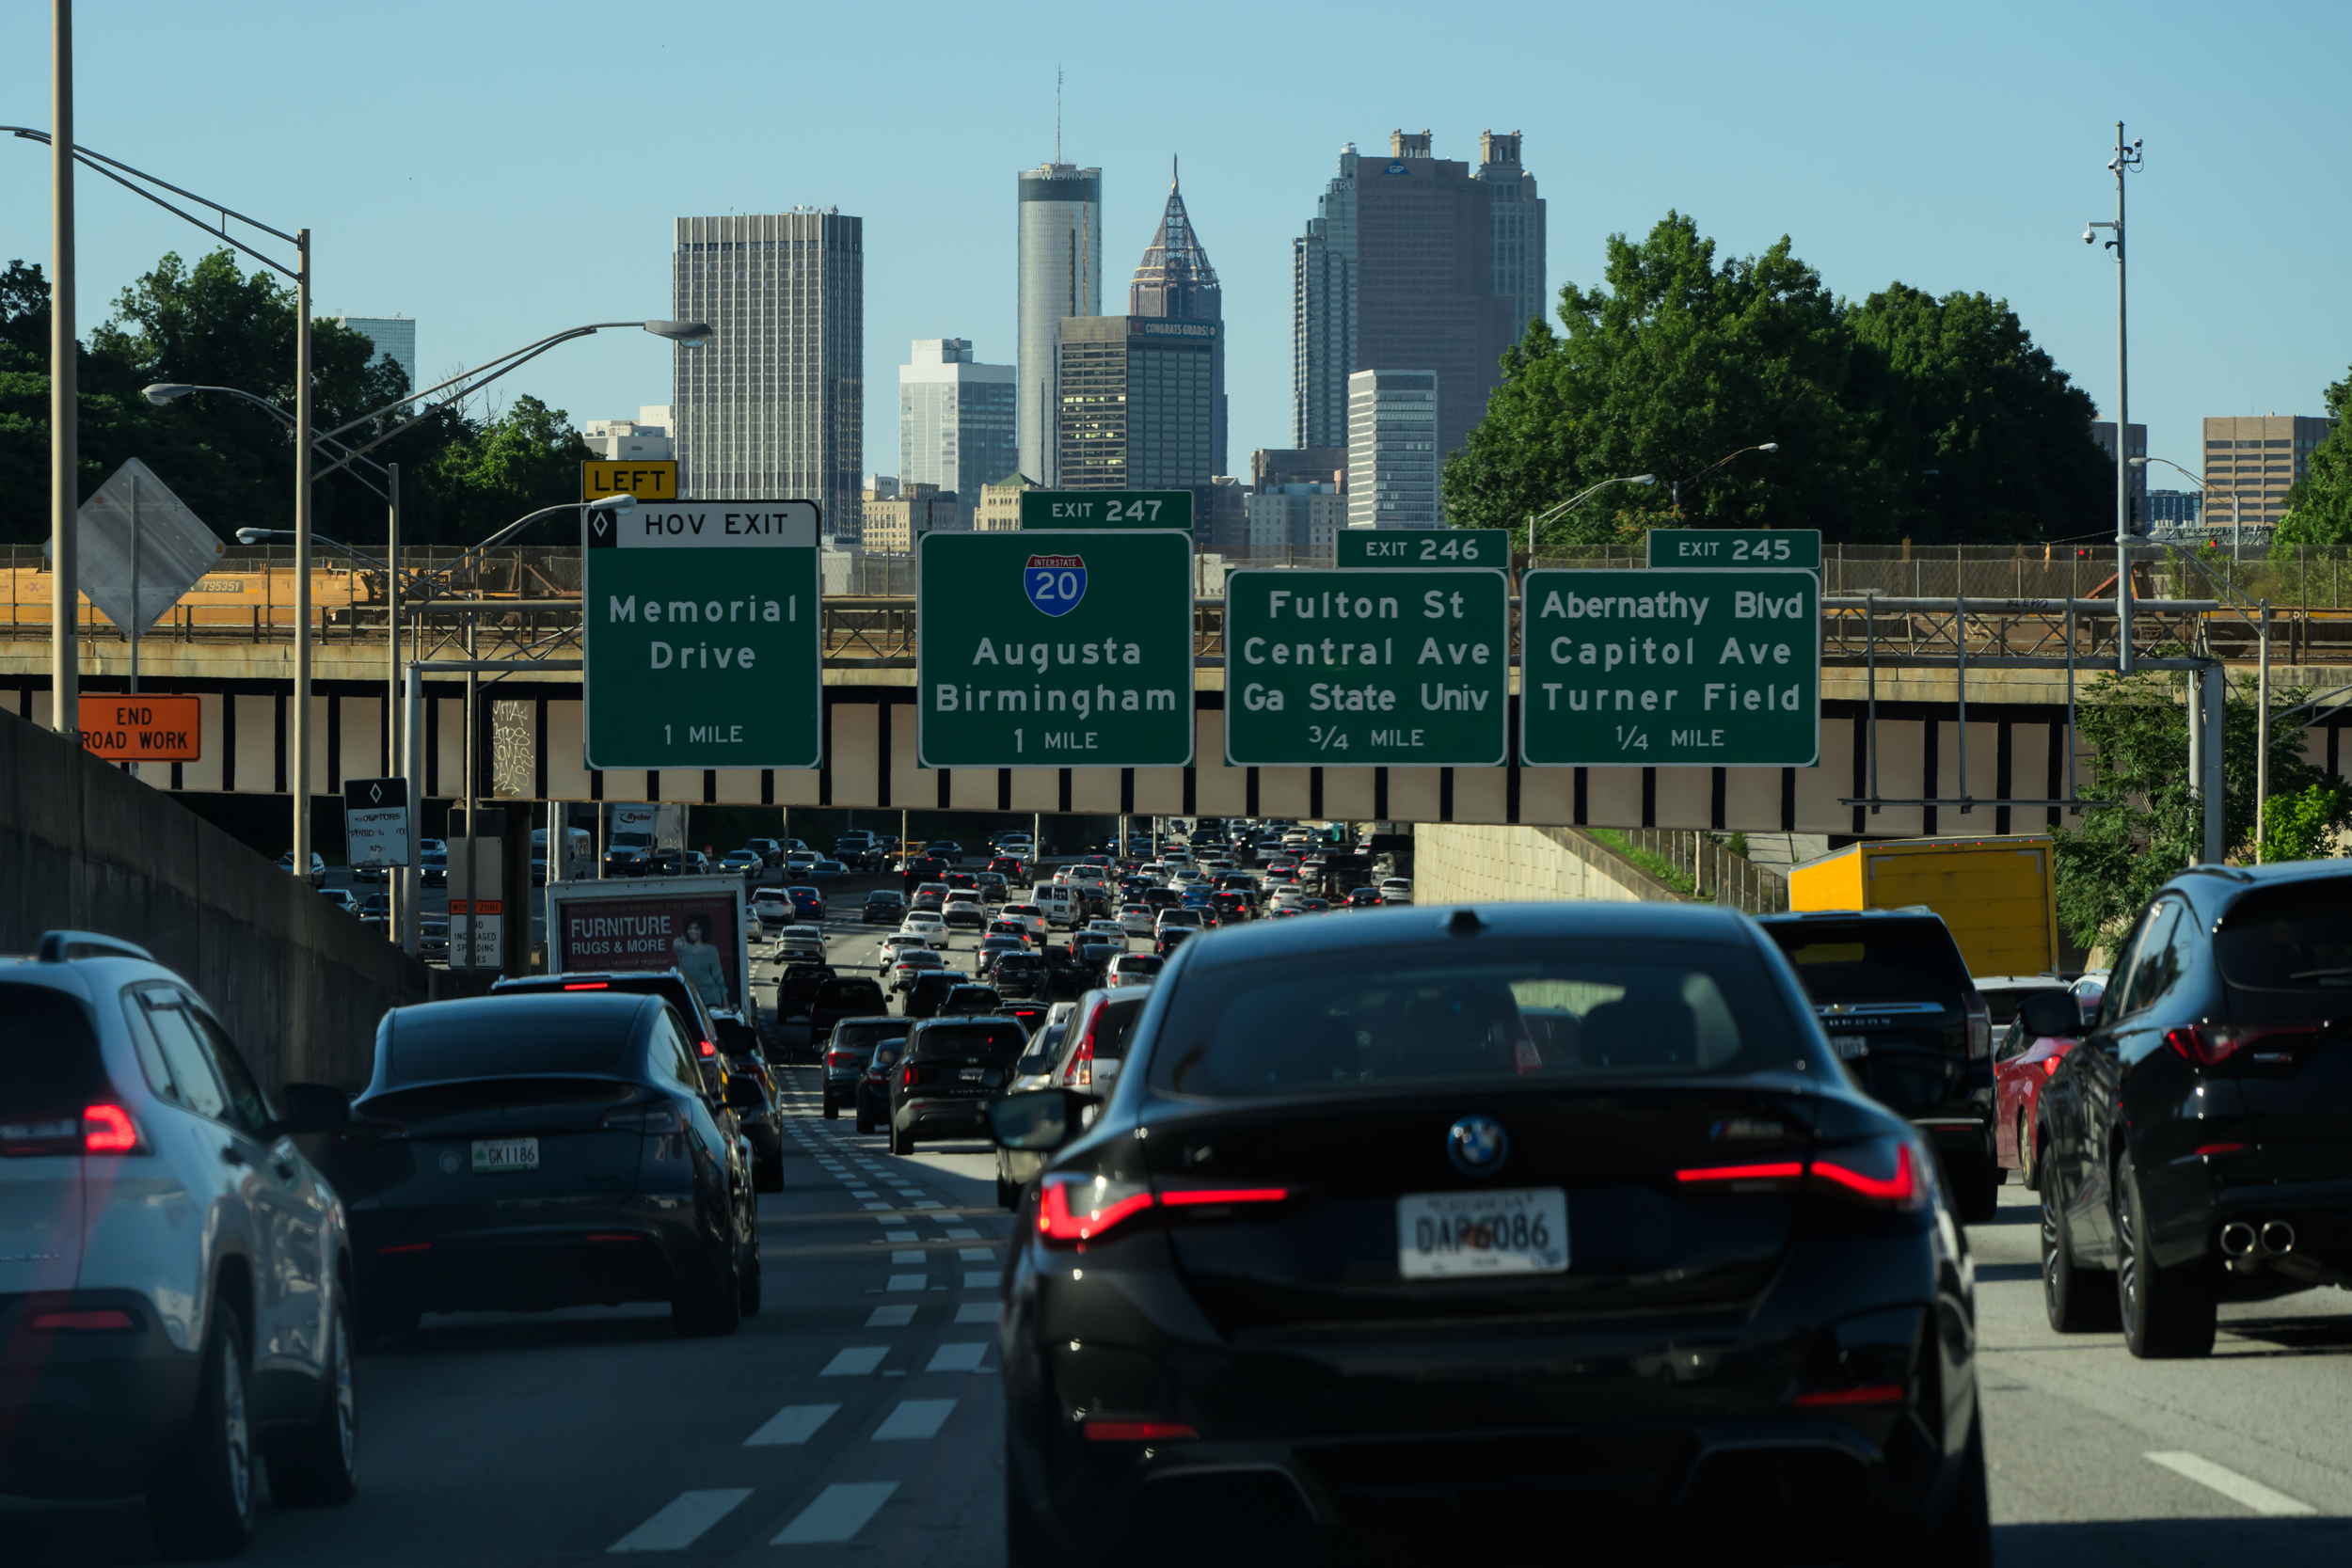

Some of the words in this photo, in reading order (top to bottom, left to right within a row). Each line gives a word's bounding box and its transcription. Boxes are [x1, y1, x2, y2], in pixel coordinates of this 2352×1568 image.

[1146, 323, 1182, 335] CONGRATS
[1183, 325, 1209, 337] GRADS!
[595, 469, 666, 492] LEFT
[1052, 502, 1093, 517] EXIT
[1105, 499, 1163, 522] 247
[645, 514, 707, 535] HOV
[724, 513, 788, 535] EXIT
[1366, 541, 1408, 557] EXIT
[1419, 538, 1479, 561] 246
[1678, 541, 1720, 557] EXIT
[1732, 539, 1791, 561] 245
[1034, 558, 1077, 567] INTERSTATE
[202, 580, 240, 592] 795351
[1035, 571, 1077, 600] 20
[610, 594, 796, 623] Memorial
[1269, 590, 1398, 619] Fulton
[1422, 590, 1464, 619] St
[1540, 590, 1710, 626] Abernathy
[1735, 590, 1804, 619] Blvd
[650, 641, 756, 670] Drive
[972, 637, 1140, 674] Augusta
[1244, 636, 1392, 666] Central
[1417, 637, 1490, 665] Ave
[1550, 636, 1693, 673] Capitol
[1719, 637, 1791, 665] Ave
[936, 683, 1176, 721] Birmingham
[1243, 682, 1284, 711] Ga
[1309, 682, 1396, 711] State
[1421, 682, 1489, 711] Univ
[1541, 682, 1678, 711] Turner
[1704, 683, 1800, 711] Field
[117, 707, 152, 726] END
[83, 731, 127, 750] ROAD
[138, 731, 188, 750] WORK
[664, 723, 672, 745] 1
[689, 725, 743, 743] MILE
[1014, 728, 1023, 753] 1
[1044, 731, 1099, 750] MILE
[1371, 728, 1424, 747] MILE
[1671, 729, 1724, 747] MILE
[628, 813, 652, 825] Ryder
[683, 901, 702, 910] HOME
[454, 932, 497, 942] INCASED
[570, 915, 672, 939] FURNITURE
[456, 943, 495, 953] SPDING
[572, 942, 611, 955] RUGS
[613, 941, 623, 954] &
[628, 939, 666, 953] MORE
